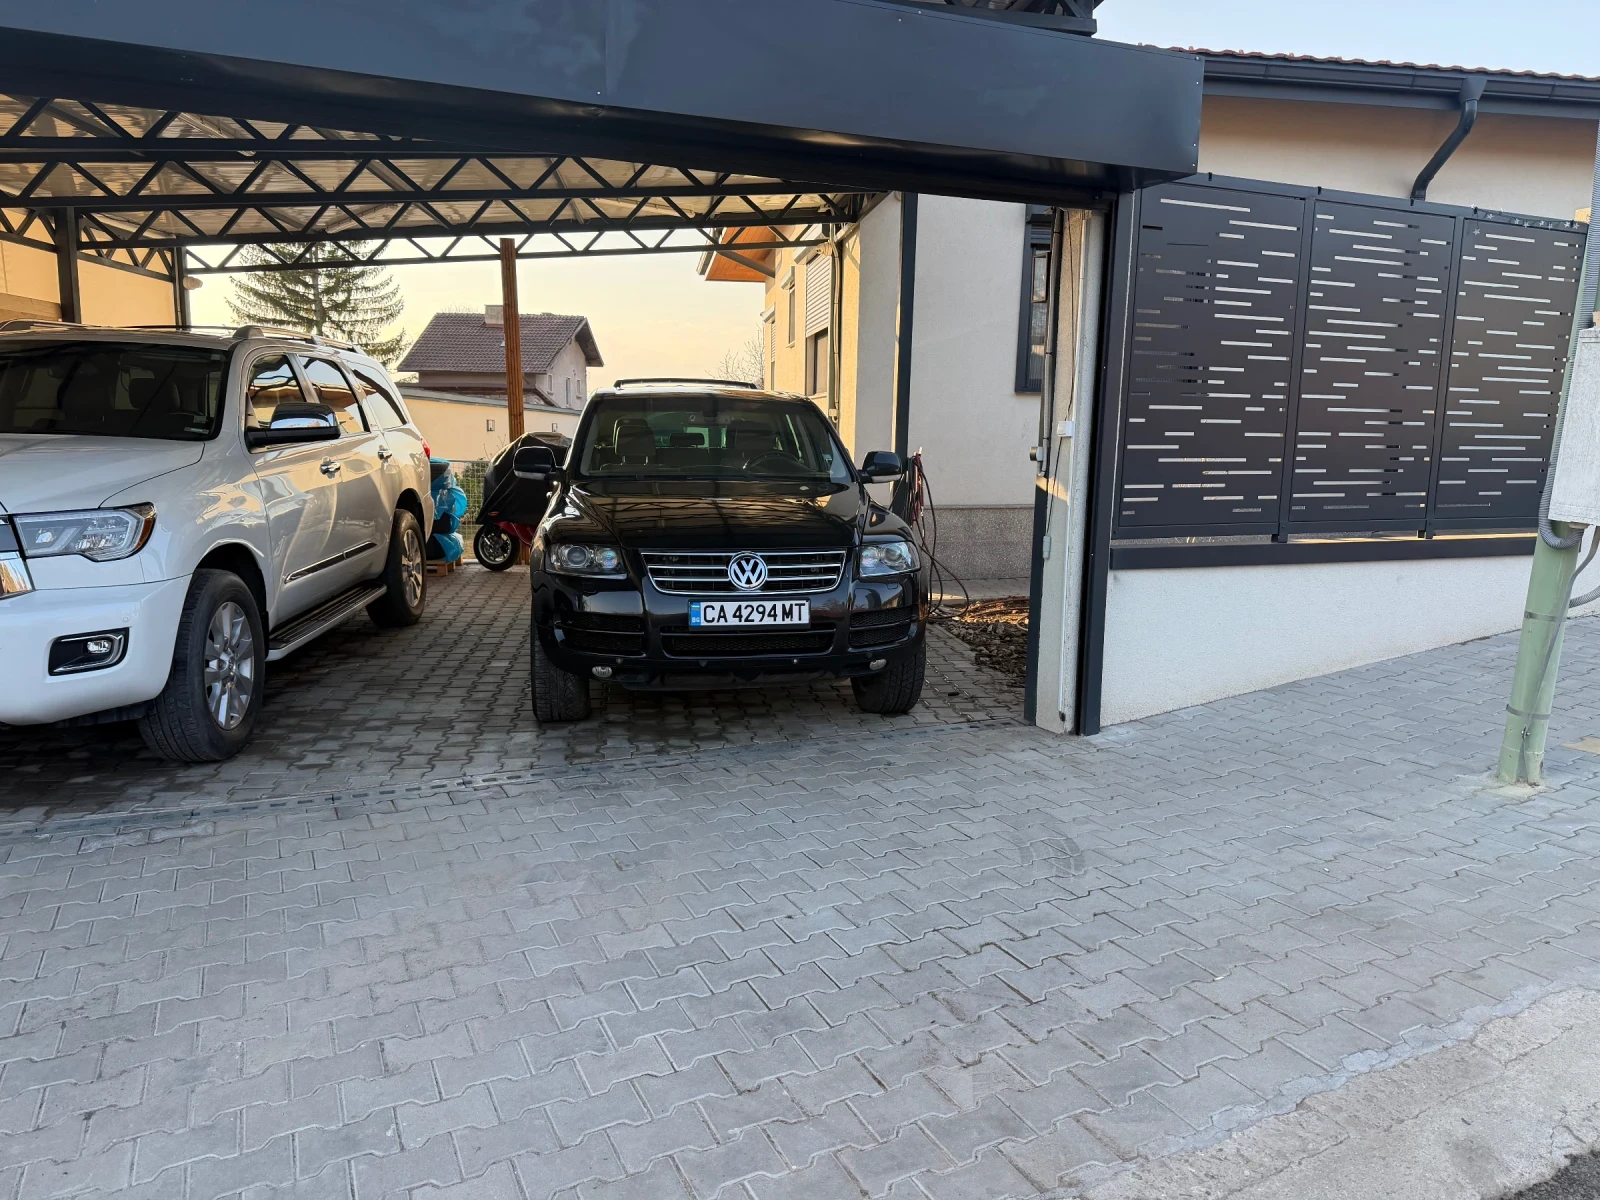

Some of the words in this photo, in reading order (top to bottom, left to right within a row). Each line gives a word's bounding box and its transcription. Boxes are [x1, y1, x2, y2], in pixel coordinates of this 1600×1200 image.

[730, 555, 766, 588] VW
[703, 604, 728, 623] CA
[732, 603, 778, 623] 4294
[781, 602, 806, 622] MT
